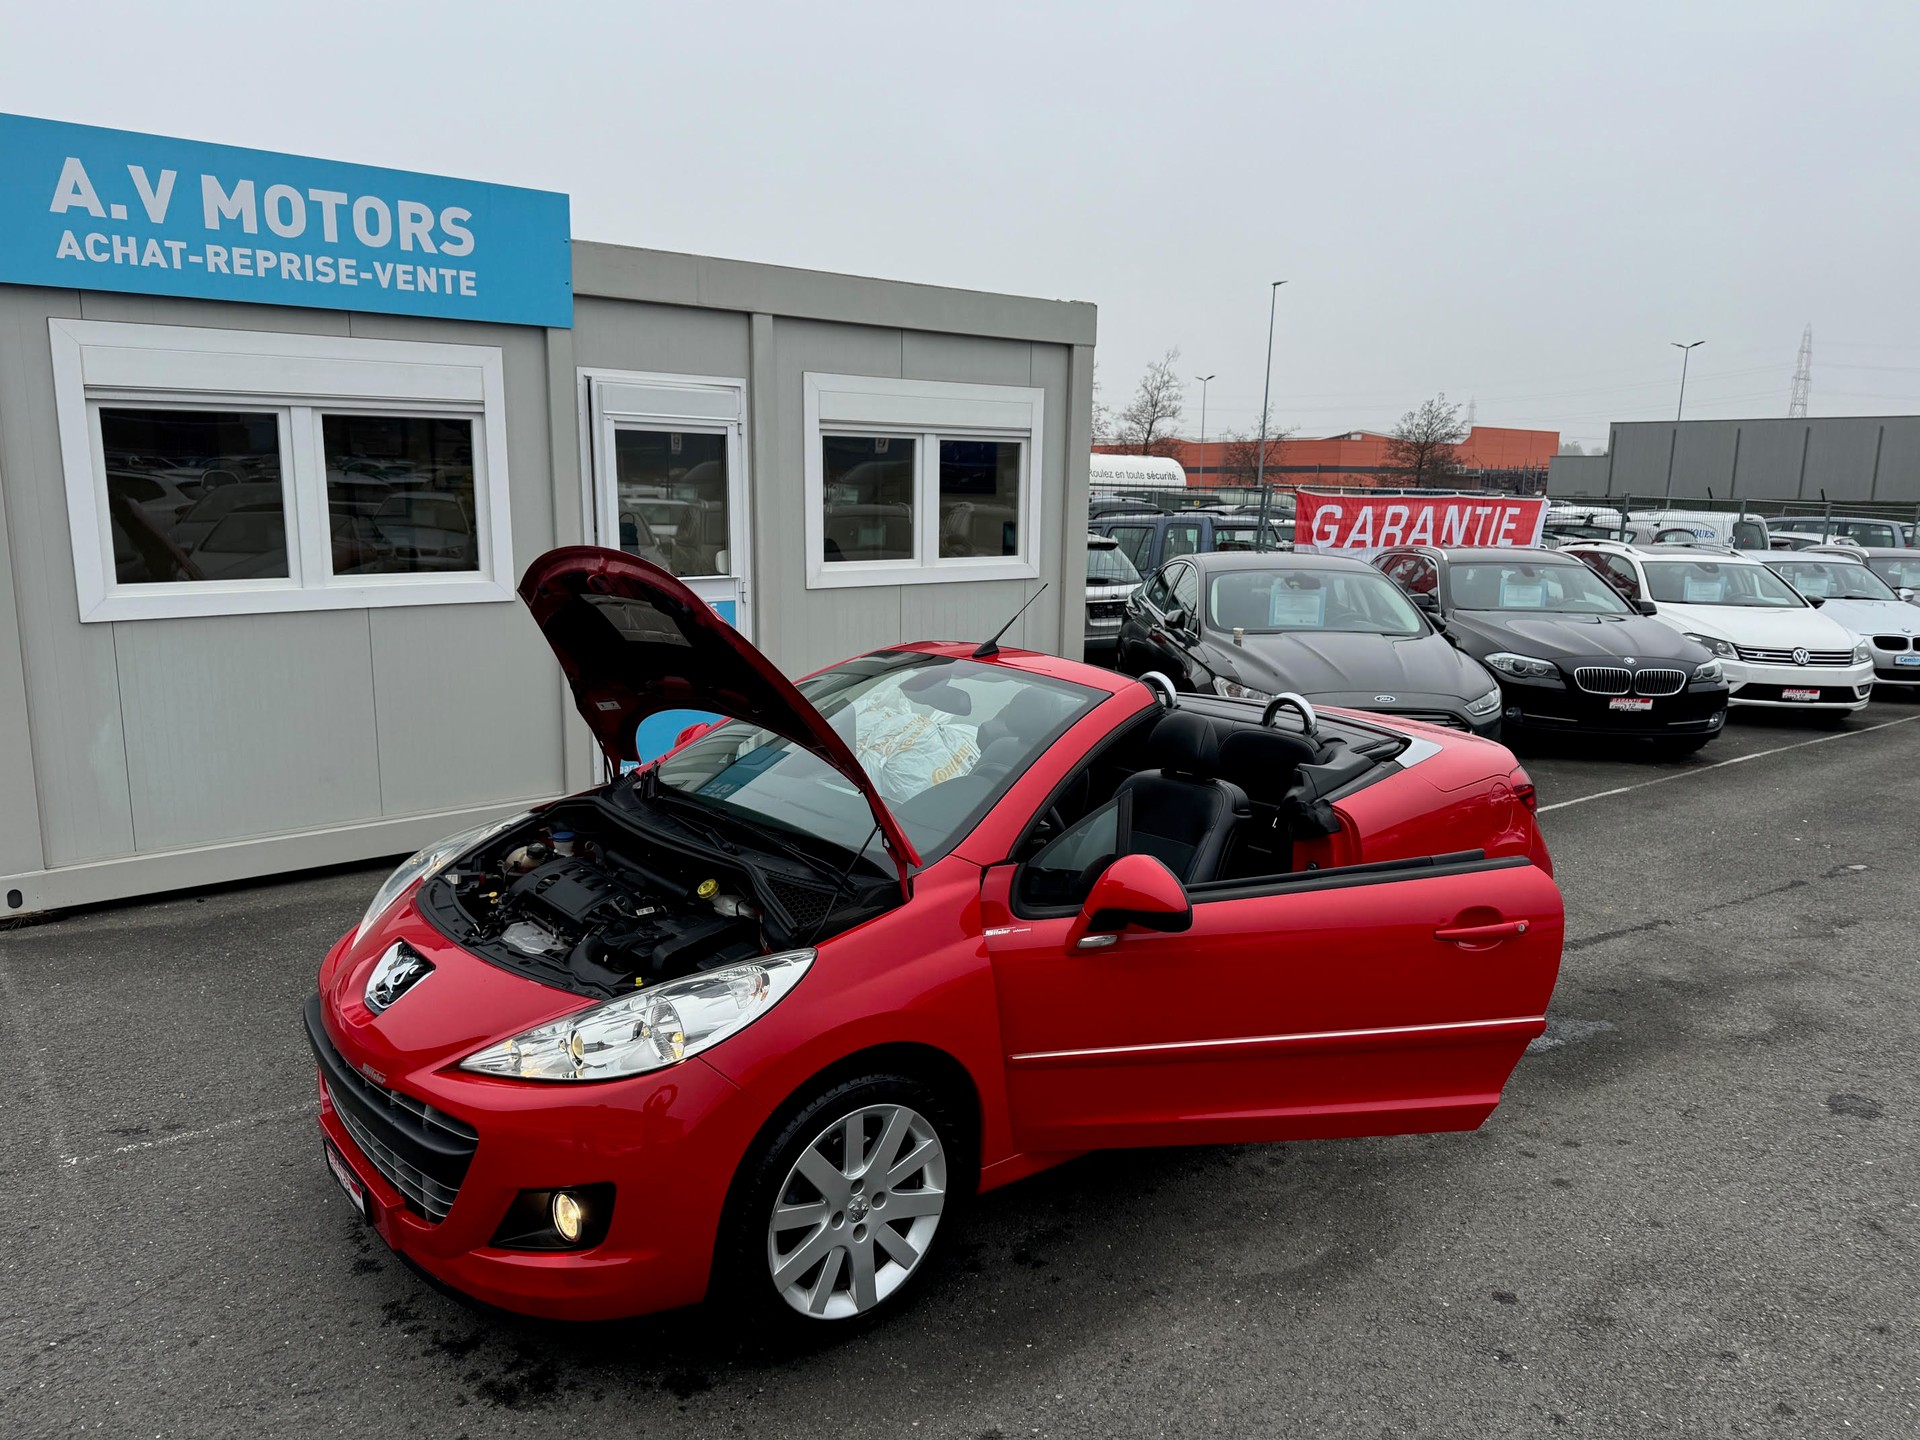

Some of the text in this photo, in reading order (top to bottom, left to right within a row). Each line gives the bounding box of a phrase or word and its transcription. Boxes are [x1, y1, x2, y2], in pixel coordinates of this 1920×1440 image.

[49, 157, 475, 257] A.V MOTORS
[56, 230, 477, 296] ACHAT-REPRISE-VENTE
[1126, 470, 1144, 479] toute
[1311, 504, 1520, 548] GARANTIE
